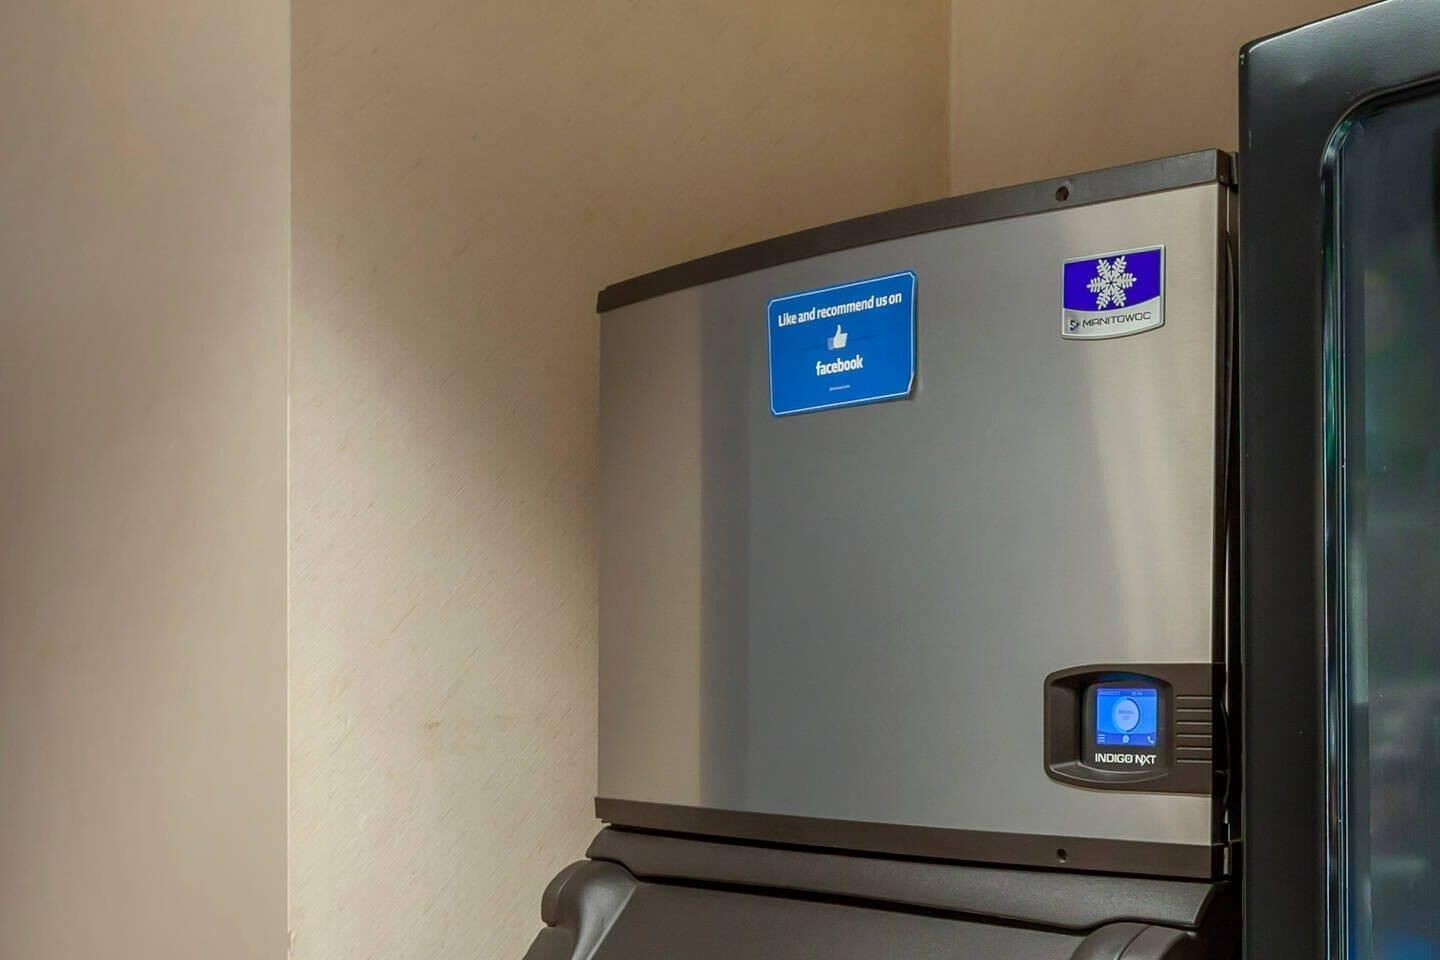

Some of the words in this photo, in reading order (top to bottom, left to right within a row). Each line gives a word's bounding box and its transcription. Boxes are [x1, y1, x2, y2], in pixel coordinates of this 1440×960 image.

[778, 314, 797, 327] Like
[798, 307, 816, 323] and
[817, 296, 874, 320] recommend
[876, 297, 888, 308] us
[888, 293, 902, 304] on
[1082, 311, 1152, 328] MANITOWOC
[816, 354, 863, 376] facebook
[1095, 752, 1133, 764] INDIGO
[1134, 754, 1157, 767] NXT
